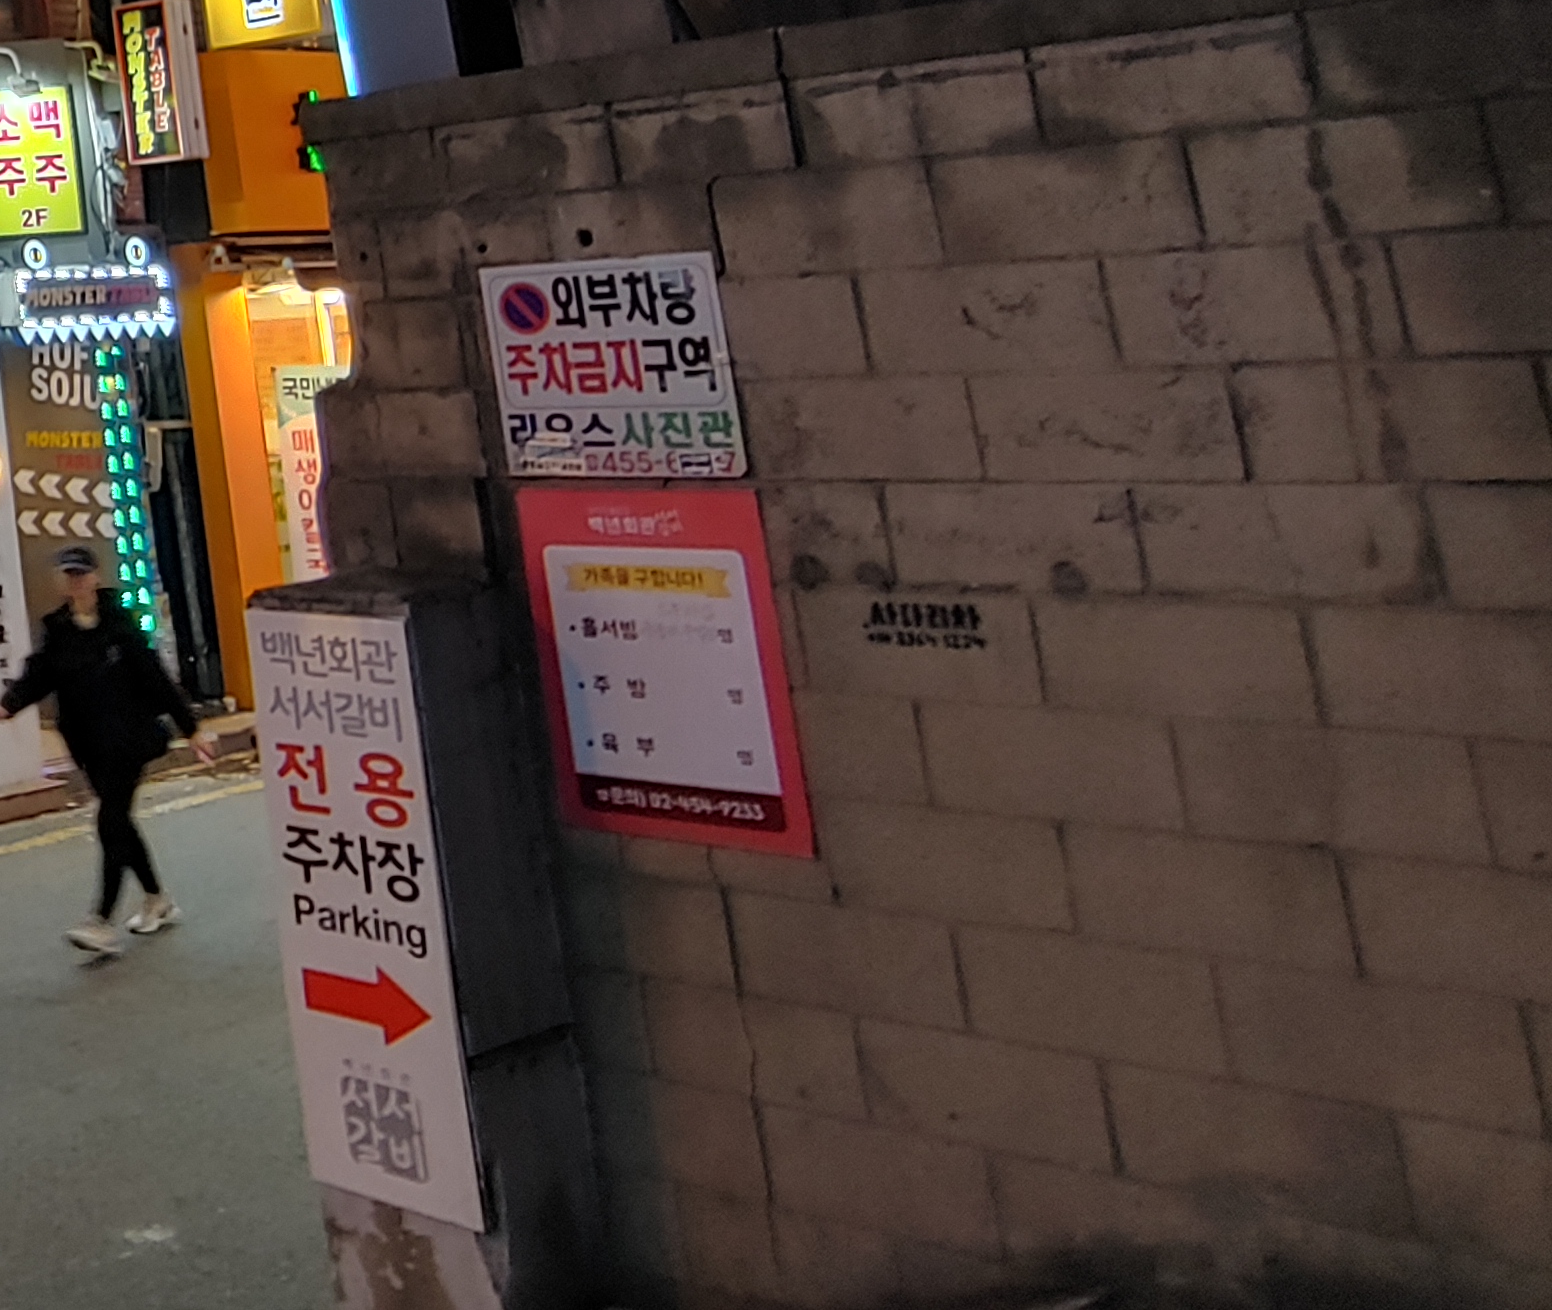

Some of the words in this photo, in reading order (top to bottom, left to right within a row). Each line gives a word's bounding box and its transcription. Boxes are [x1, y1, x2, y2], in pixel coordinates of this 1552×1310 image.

[122, 10, 155, 156] MONSTER
[145, 26, 170, 133] TABLE
[21, 208, 48, 228] 2F
[27, 284, 107, 307] MONSTER
[506, 335, 719, 396] 주차금지구역
[583, 566, 629, 585] 가족을
[633, 568, 704, 588] 구합니다!
[581, 616, 639, 641] 홀서빙
[870, 600, 982, 632] 사다리차
[259, 629, 397, 687] 백년회관
[268, 685, 405, 743] 서서갈비
[282, 825, 425, 903] 주차장
[292, 894, 429, 959] Parking
